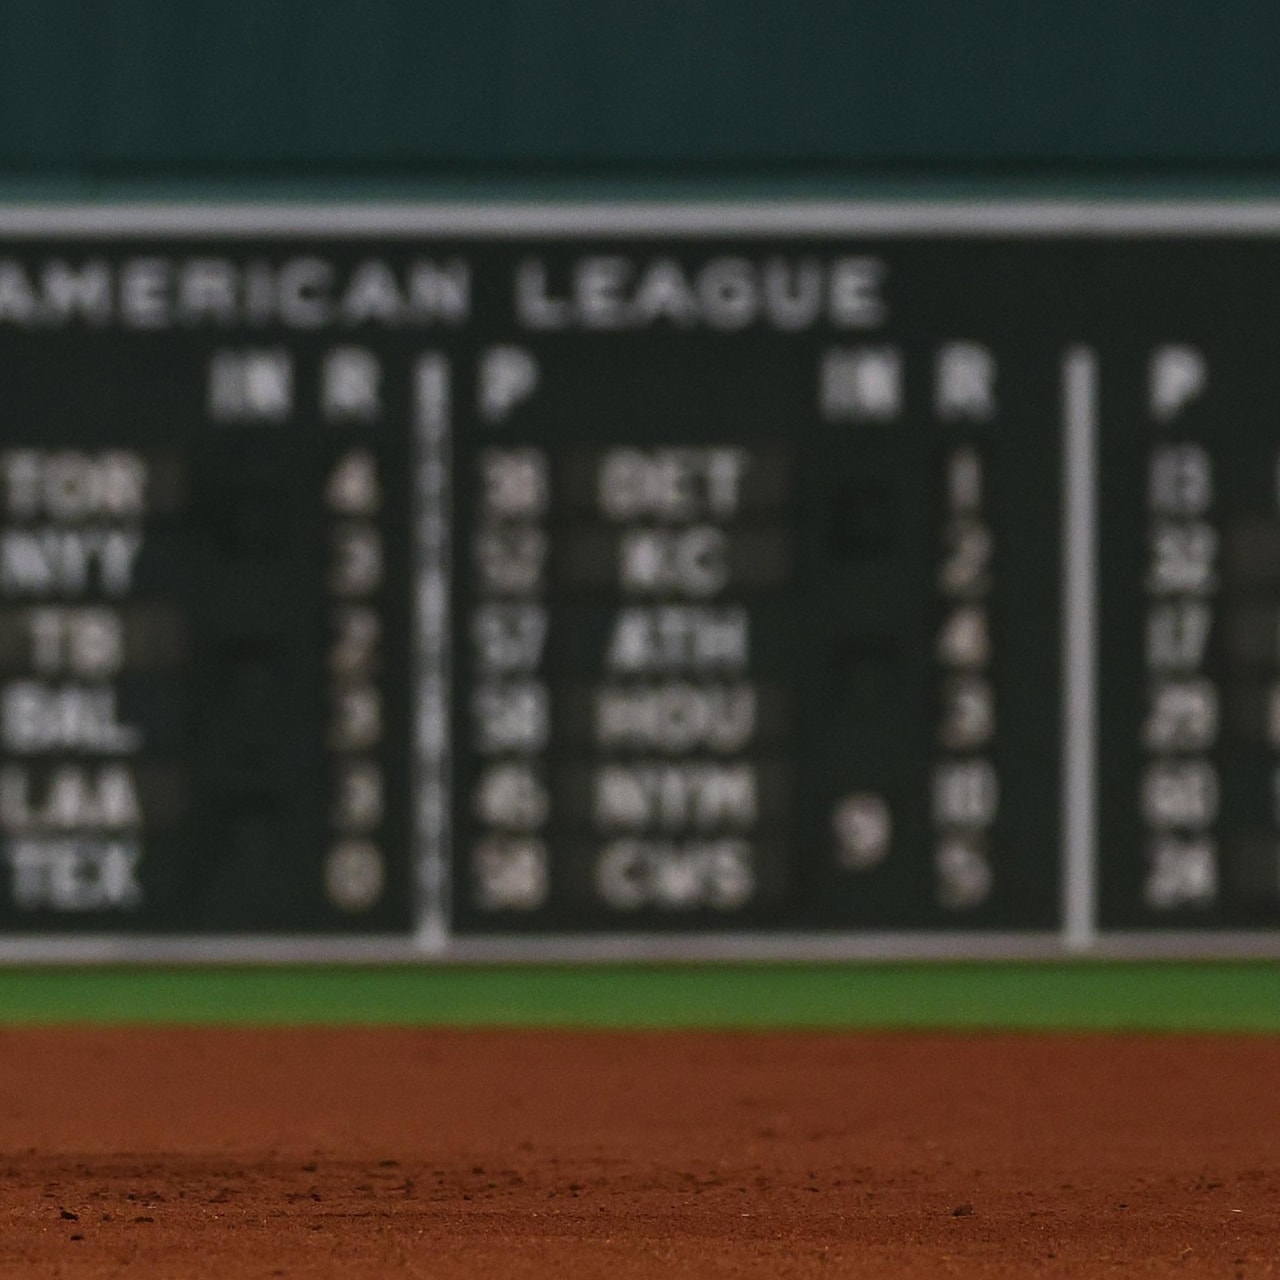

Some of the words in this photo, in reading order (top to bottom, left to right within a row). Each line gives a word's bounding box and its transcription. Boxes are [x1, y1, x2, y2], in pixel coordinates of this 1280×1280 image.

[518, 258, 880, 328] LEAGUE
[212, 354, 290, 416] IN
[324, 349, 378, 413] R
[481, 347, 536, 416] P
[824, 352, 899, 415] IN
[938, 344, 993, 414] R
[1151, 347, 1204, 414] P
[1, 448, 142, 517] TOR
[597, 447, 748, 517] DET
[949, 450, 981, 520] 1
[0, 529, 138, 589] NYY
[620, 526, 729, 596] KC
[610, 606, 746, 671] ATH
[2, 674, 132, 751] BAL
[596, 682, 758, 754] HOU
[596, 764, 758, 828] NYM
[7, 834, 138, 908] TEX
[326, 839, 383, 907] 0
[598, 839, 755, 911] CWS
